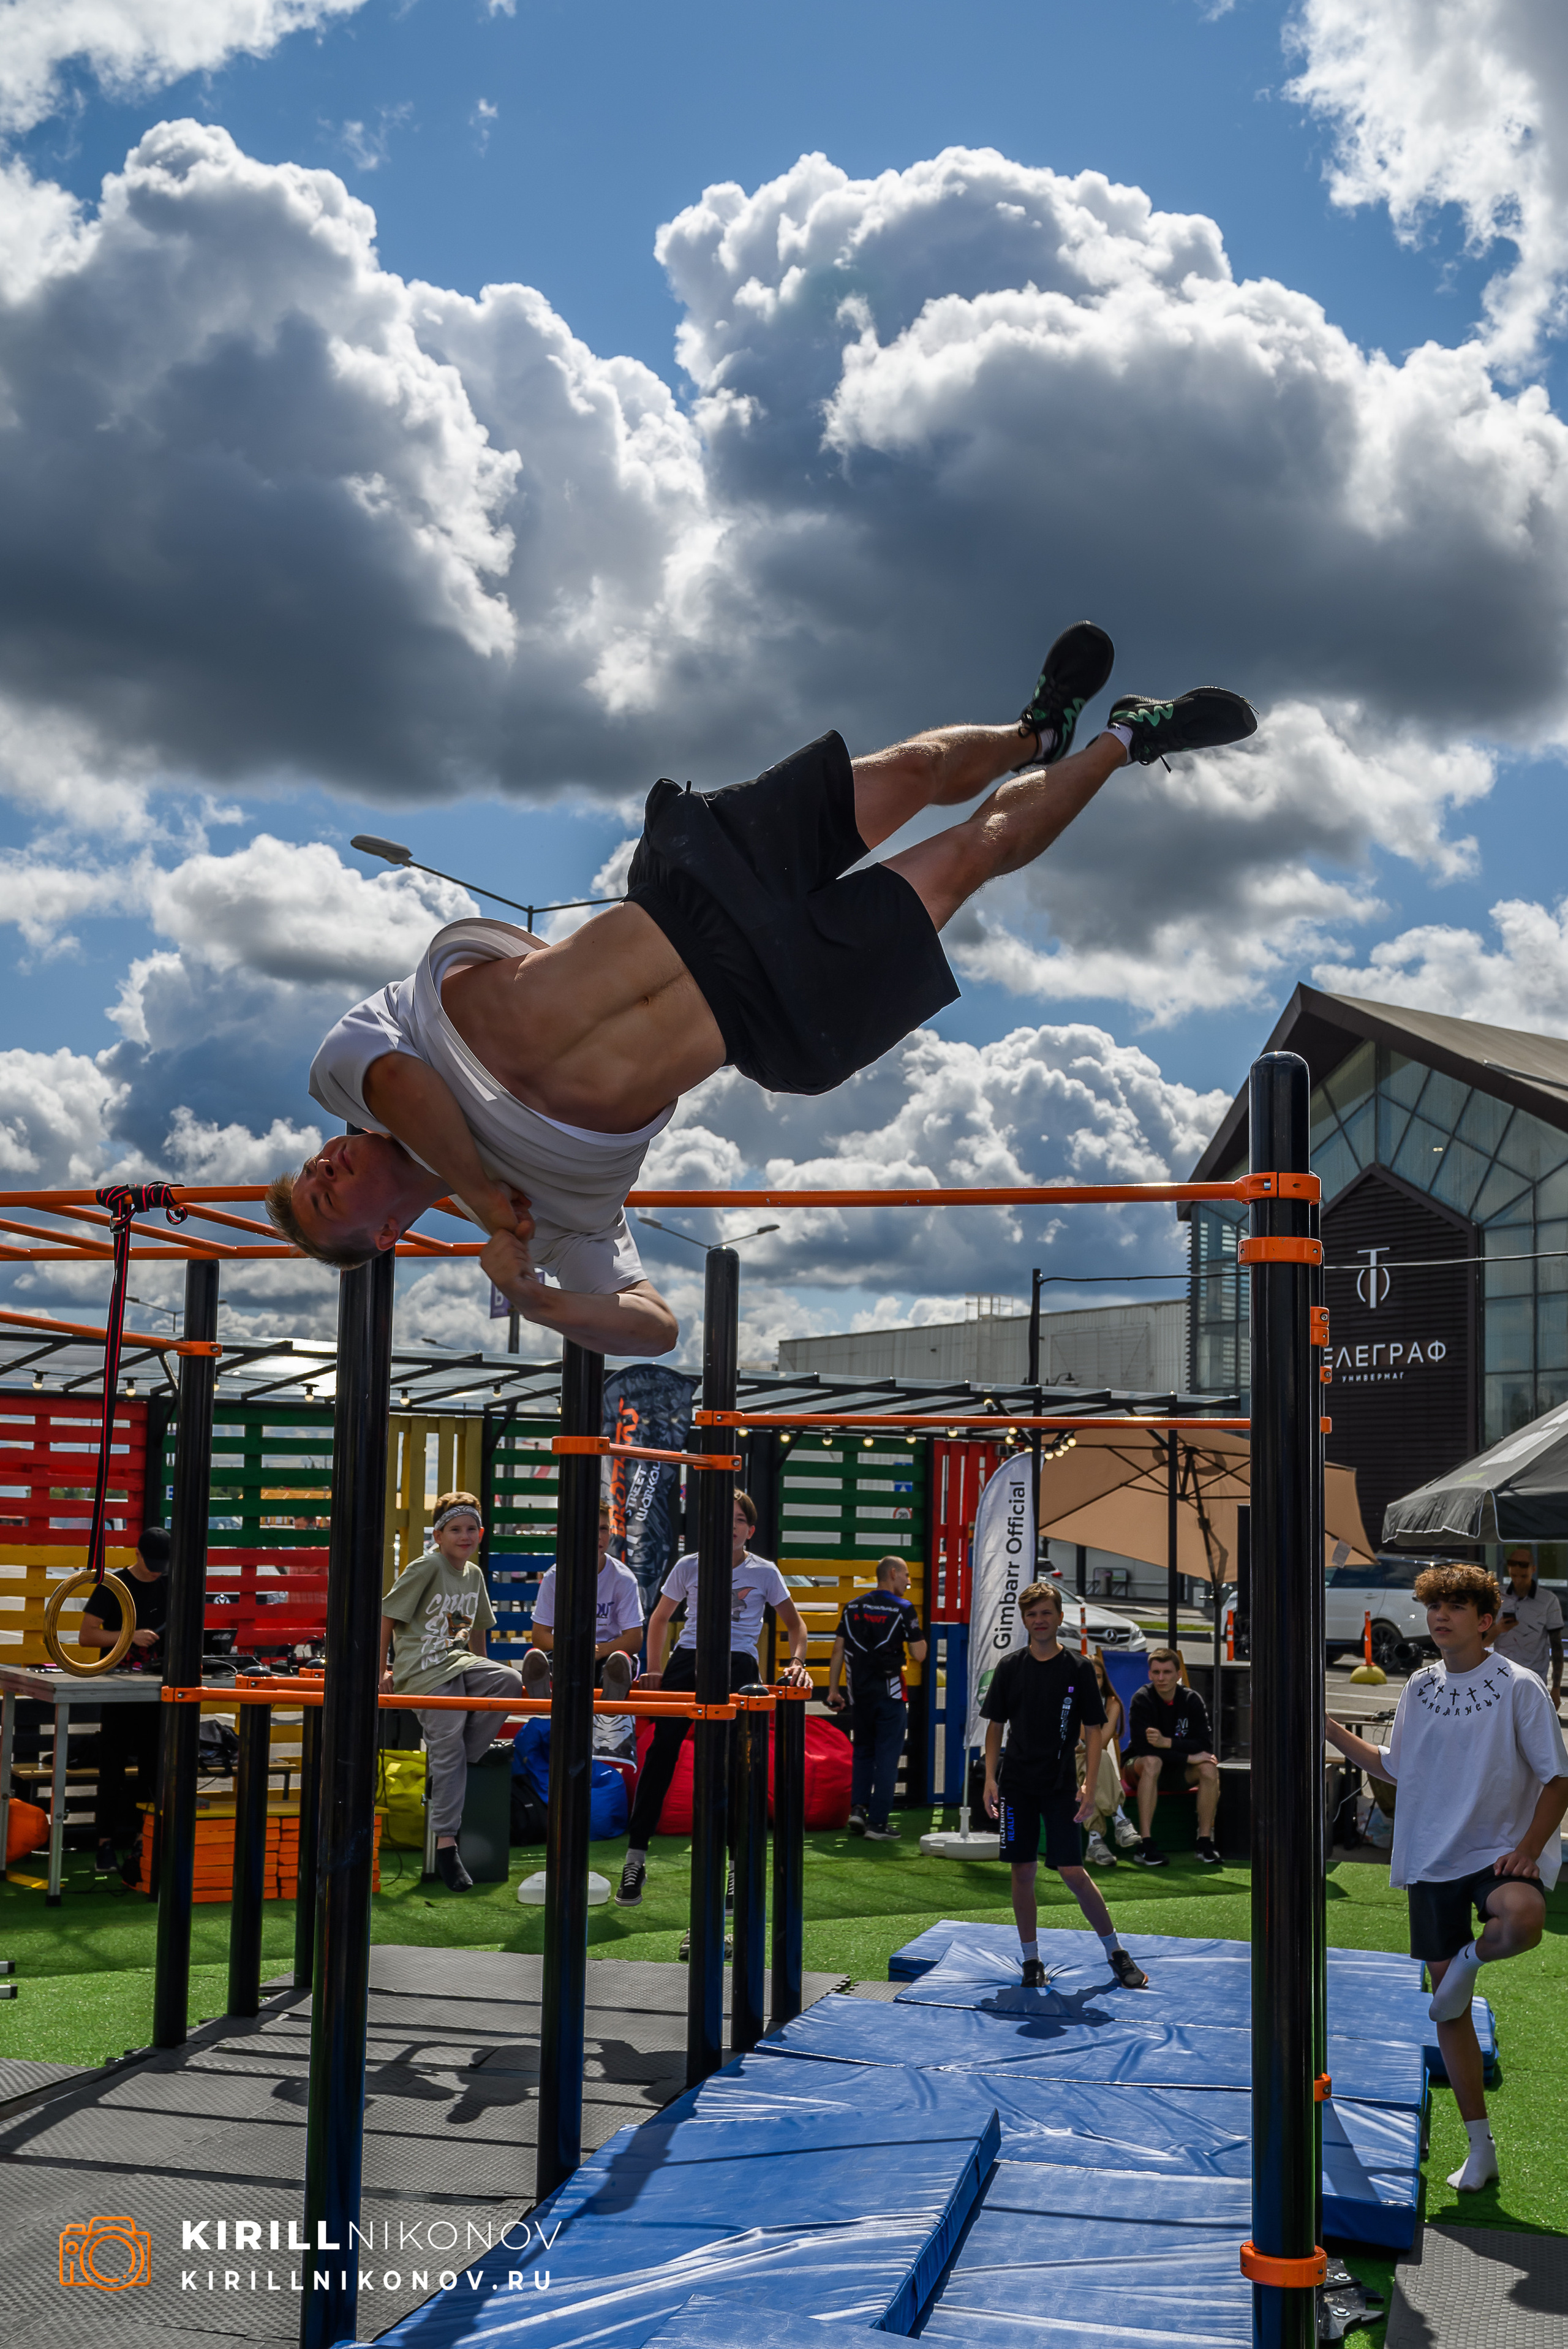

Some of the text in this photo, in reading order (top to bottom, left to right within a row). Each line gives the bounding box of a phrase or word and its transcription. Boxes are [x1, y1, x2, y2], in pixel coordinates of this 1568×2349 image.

[1324, 1340, 1446, 1368] ЕЛЕГРАФ
[1341, 1371, 1404, 1383] УНИВЕРМАГ
[635, 1461, 662, 1522] WORKOU
[993, 1481, 1025, 1650] Gimbarr Official
[1006, 1806, 1015, 1841] REALITY
